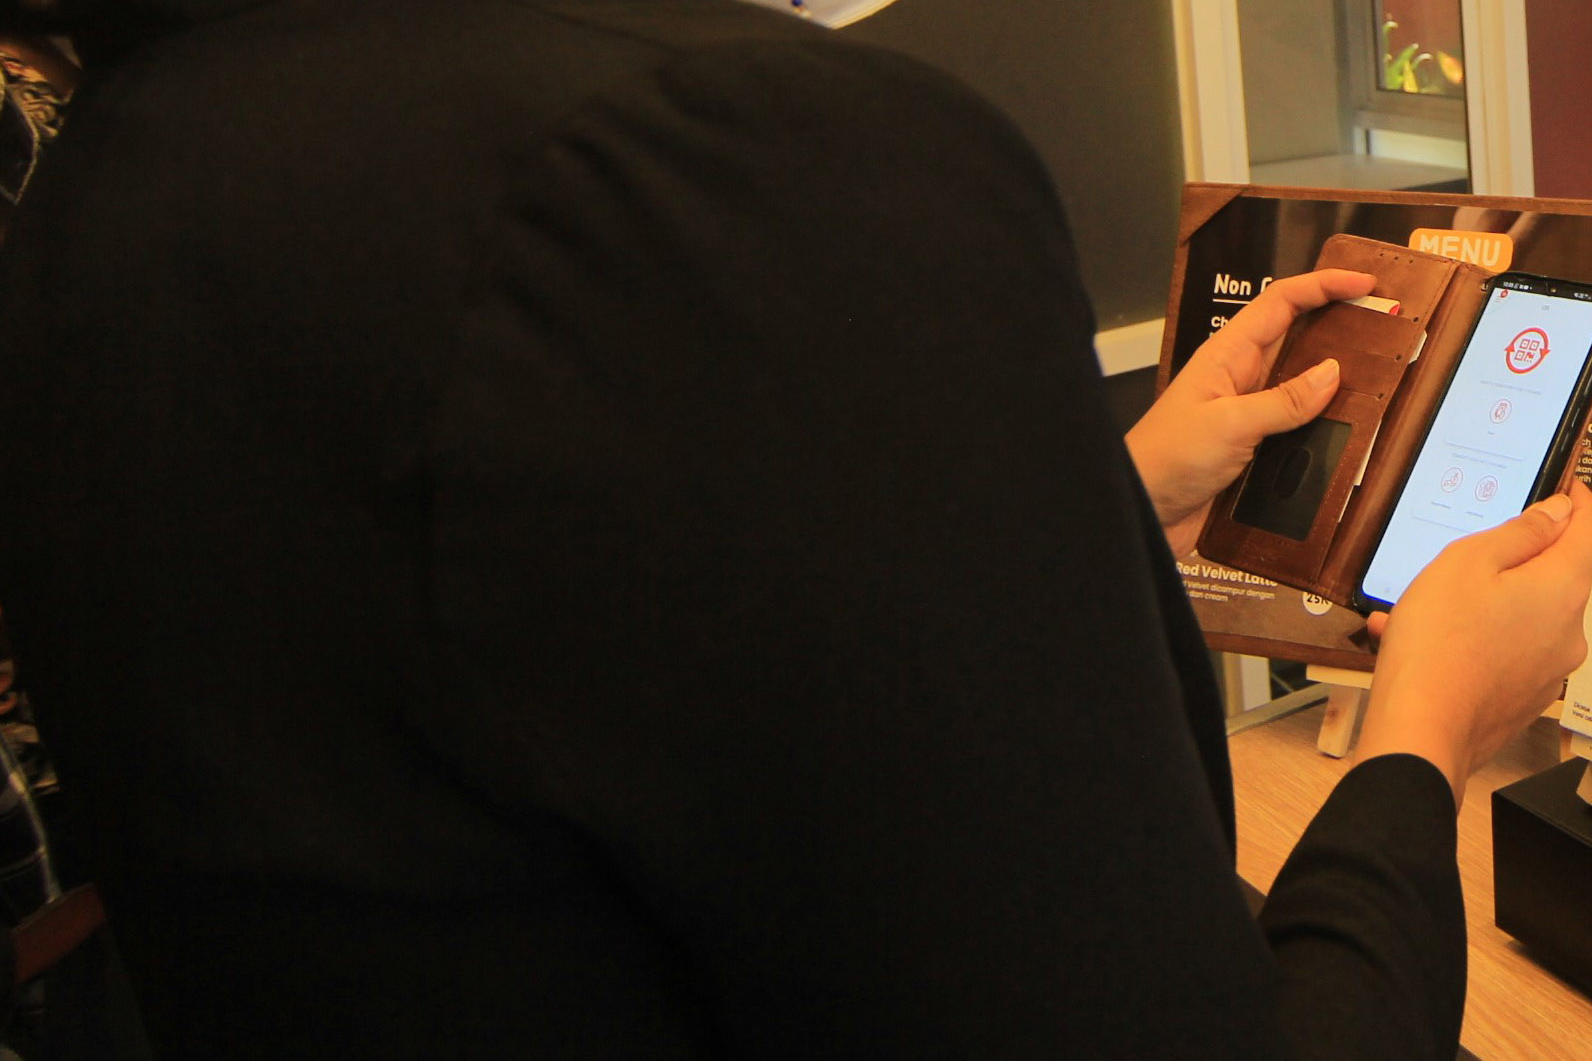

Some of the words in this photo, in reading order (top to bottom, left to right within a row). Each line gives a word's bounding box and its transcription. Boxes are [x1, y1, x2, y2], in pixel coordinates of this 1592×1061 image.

[1420, 234, 1502, 267] MENU
[1214, 273, 1252, 296] Non
[1176, 562, 1200, 577] Red
[1202, 565, 1246, 583] Velvet
